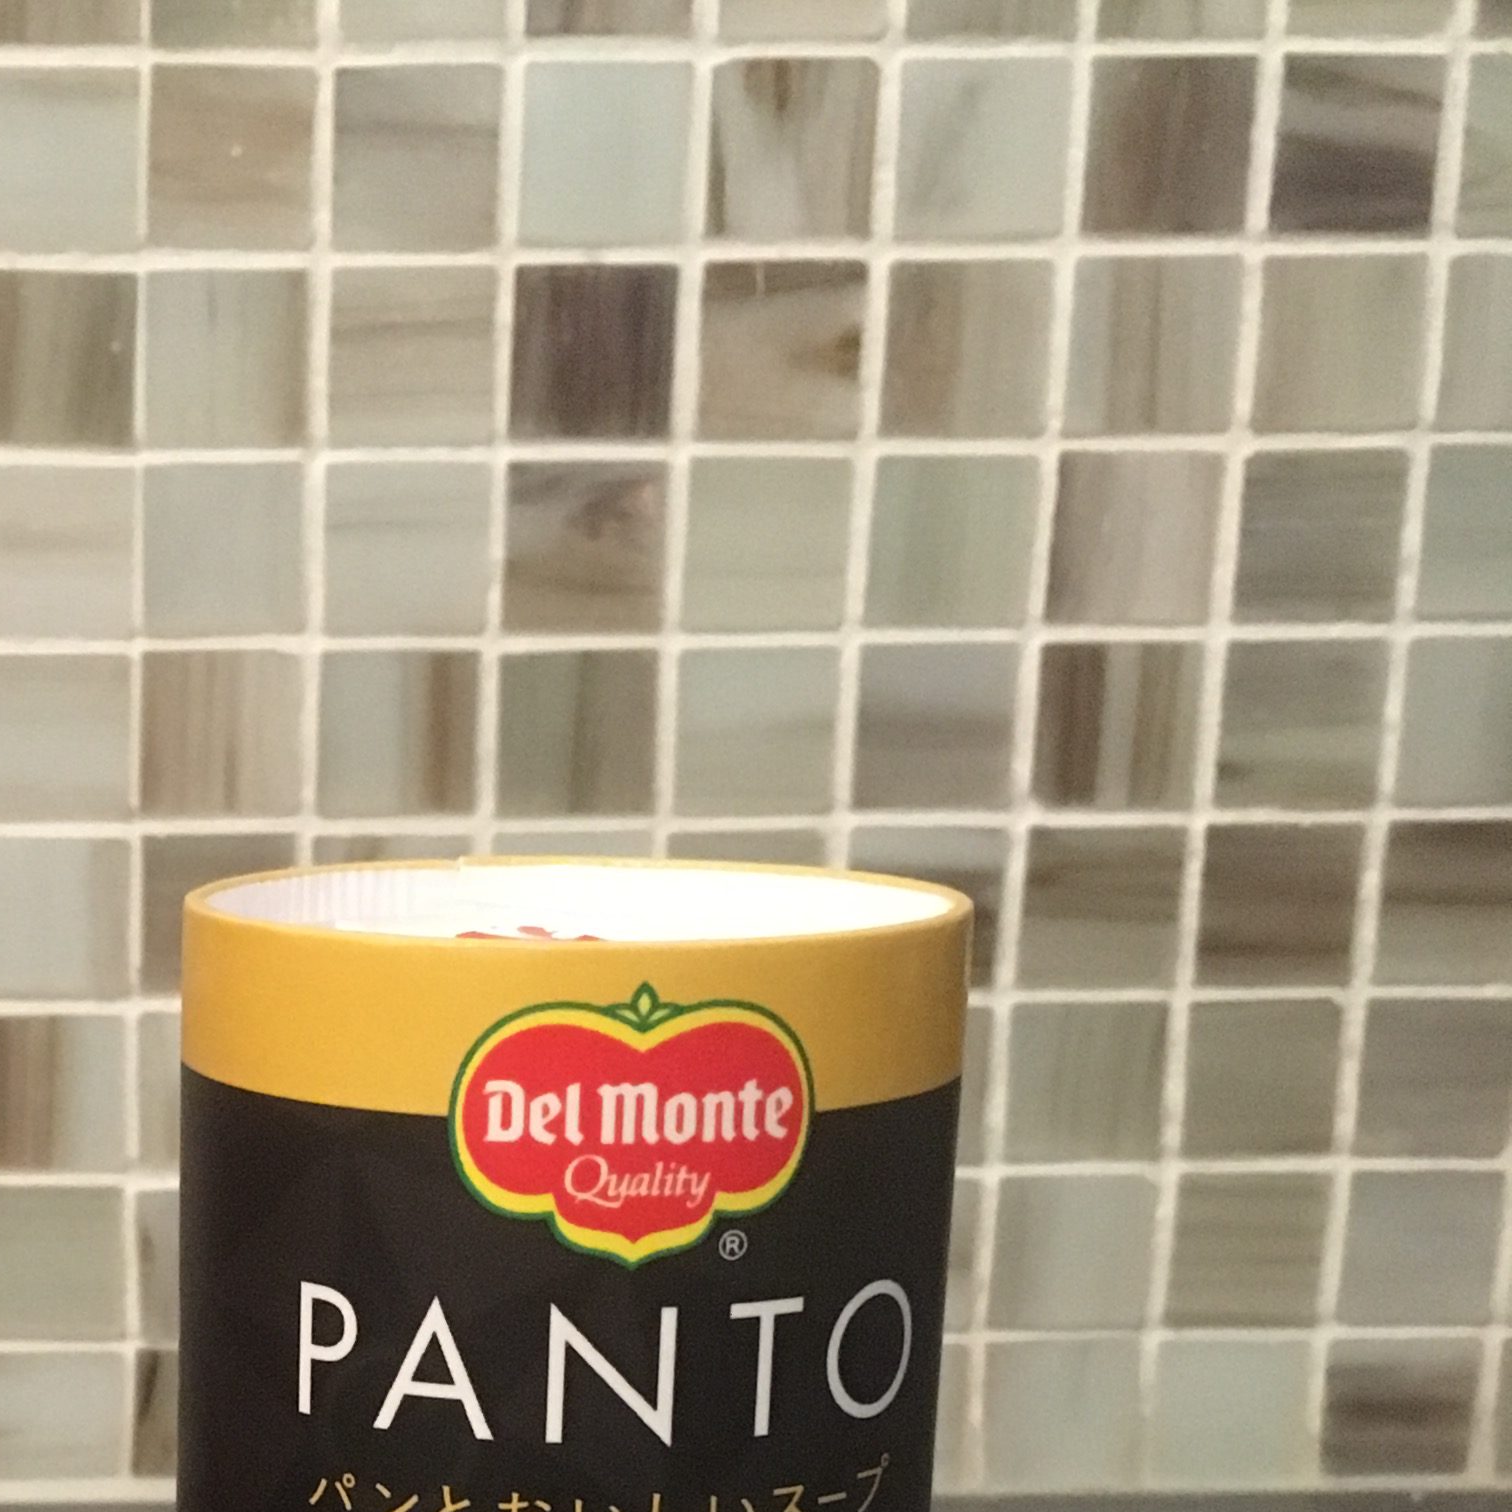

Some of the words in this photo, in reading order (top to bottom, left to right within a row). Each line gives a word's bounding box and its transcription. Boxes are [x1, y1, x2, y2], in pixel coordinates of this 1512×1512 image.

[482, 1078, 586, 1147] Del
[595, 1077, 794, 1147] Monte
[563, 1153, 713, 1209] Quality
[297, 1278, 914, 1448] PANTO
